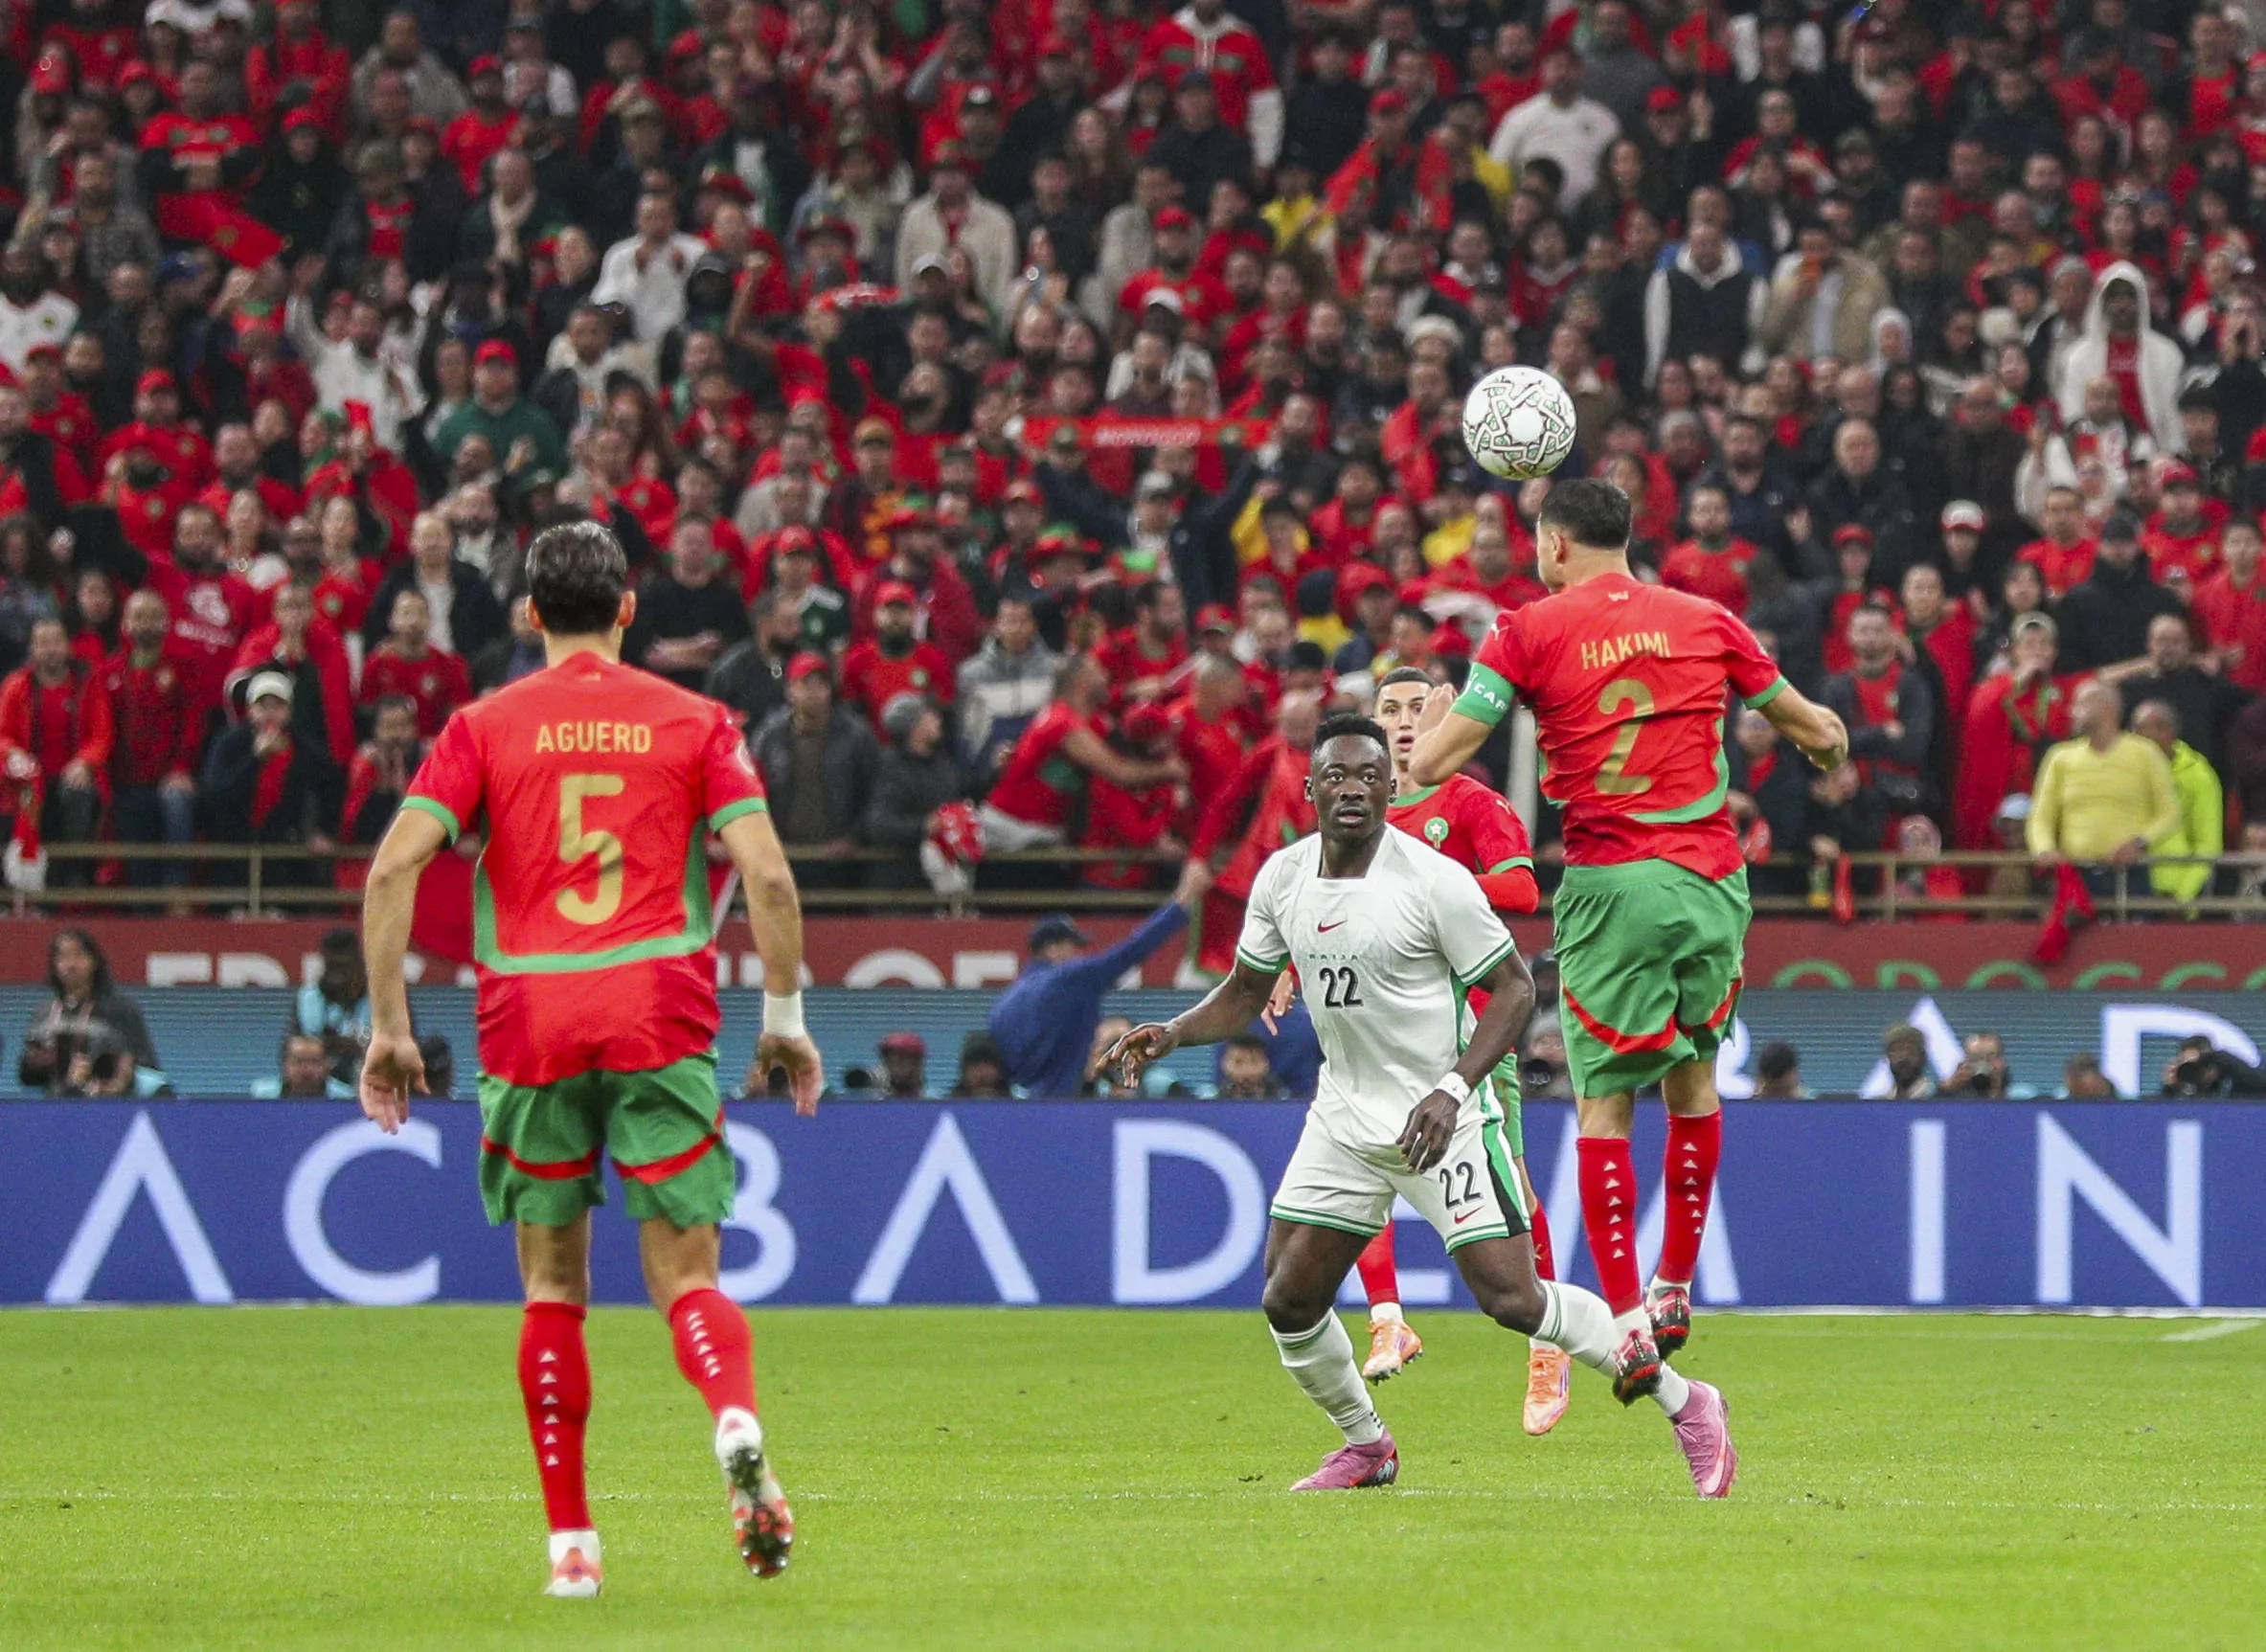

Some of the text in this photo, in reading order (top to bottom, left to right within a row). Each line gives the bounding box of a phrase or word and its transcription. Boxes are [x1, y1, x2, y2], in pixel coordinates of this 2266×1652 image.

[1581, 630, 1672, 671] HAKIMI
[535, 720, 652, 755] AGUERD
[1594, 679, 1656, 796] 2
[555, 773, 625, 926] 5
[1319, 966, 1364, 1008] 22
[1439, 1161, 1484, 1211] 22
